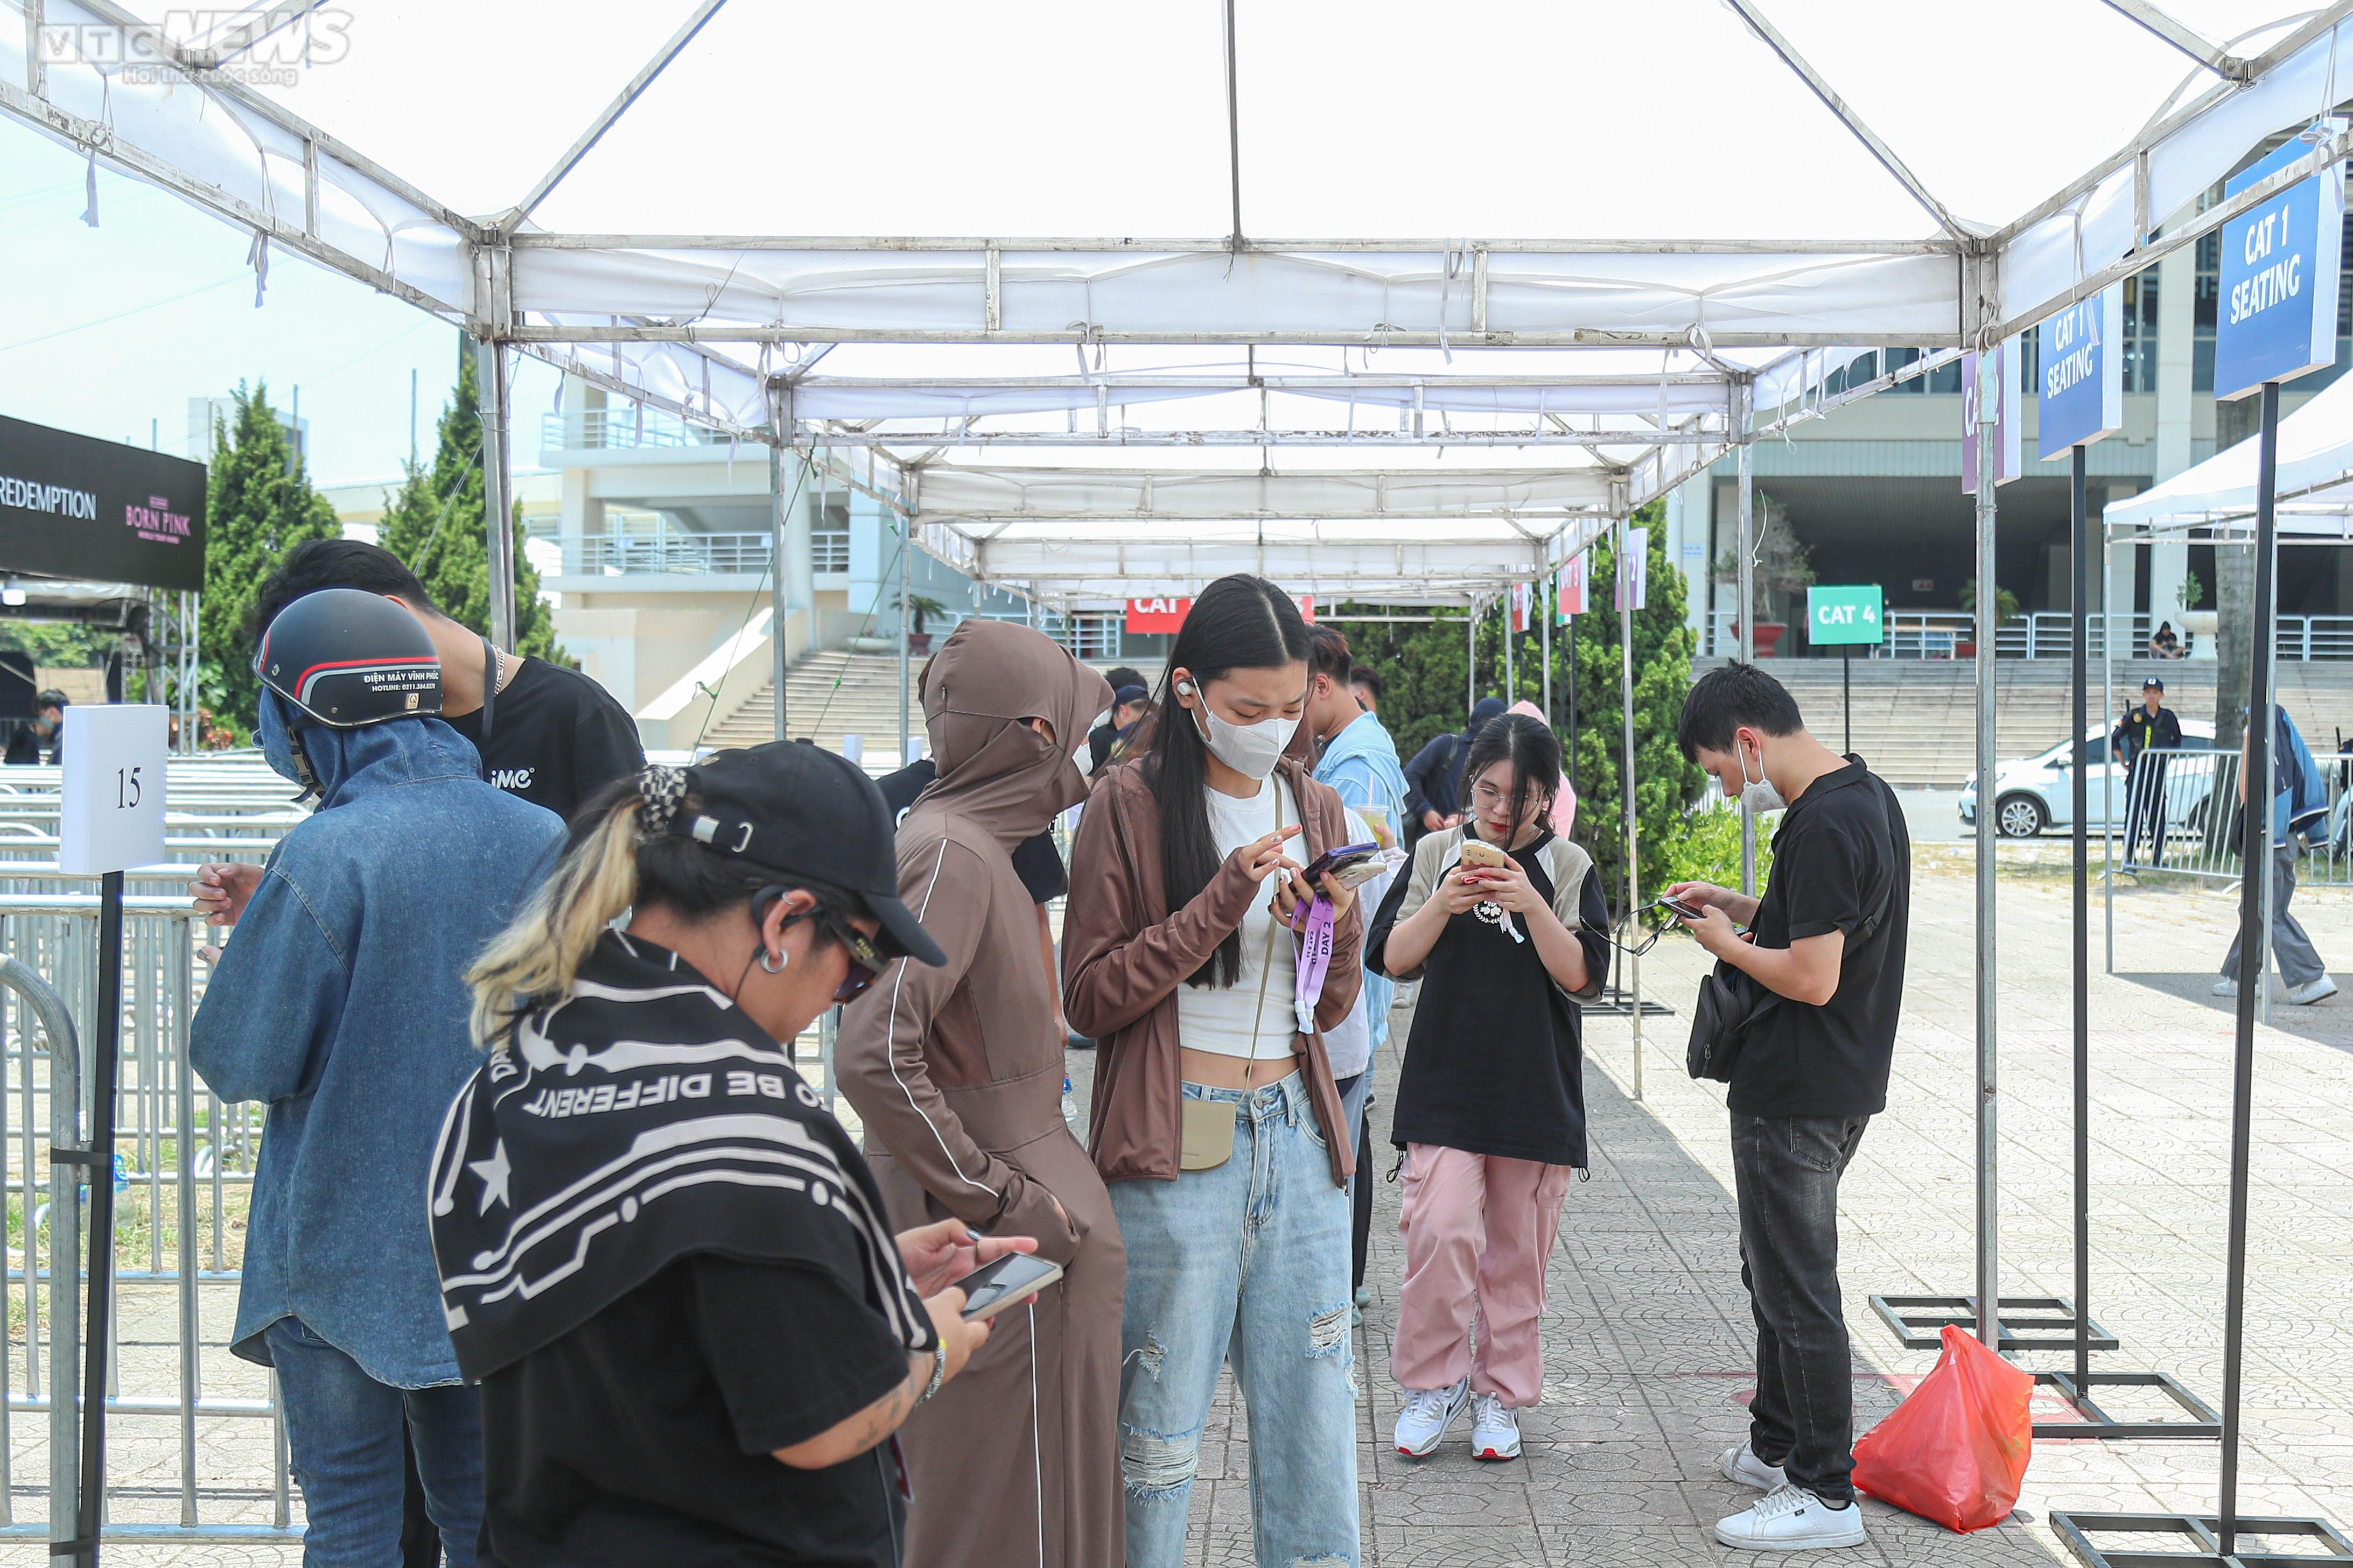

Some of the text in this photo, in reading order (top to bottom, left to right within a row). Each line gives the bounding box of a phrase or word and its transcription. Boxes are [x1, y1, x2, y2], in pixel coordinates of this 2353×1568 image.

[2244, 204, 2288, 266] CAT 1
[2230, 253, 2301, 325] SEATING
[2055, 302, 2084, 352] CAT 1
[2047, 342, 2093, 400] SEATING
[0, 475, 96, 521] REDEMPTION
[126, 505, 191, 537] BORN PINK
[1818, 604, 1876, 624] CAT 4
[363, 672, 386, 685] ĐIỆN
[387, 671, 407, 681] MÁY
[426, 670, 439, 680] PHÚC
[372, 684, 401, 692] HOTLINE:
[117, 766, 142, 809] 15
[1321, 932, 1330, 955] DAY
[522, 1073, 712, 1119] DIFFERENT
[726, 1070, 786, 1099] BE
